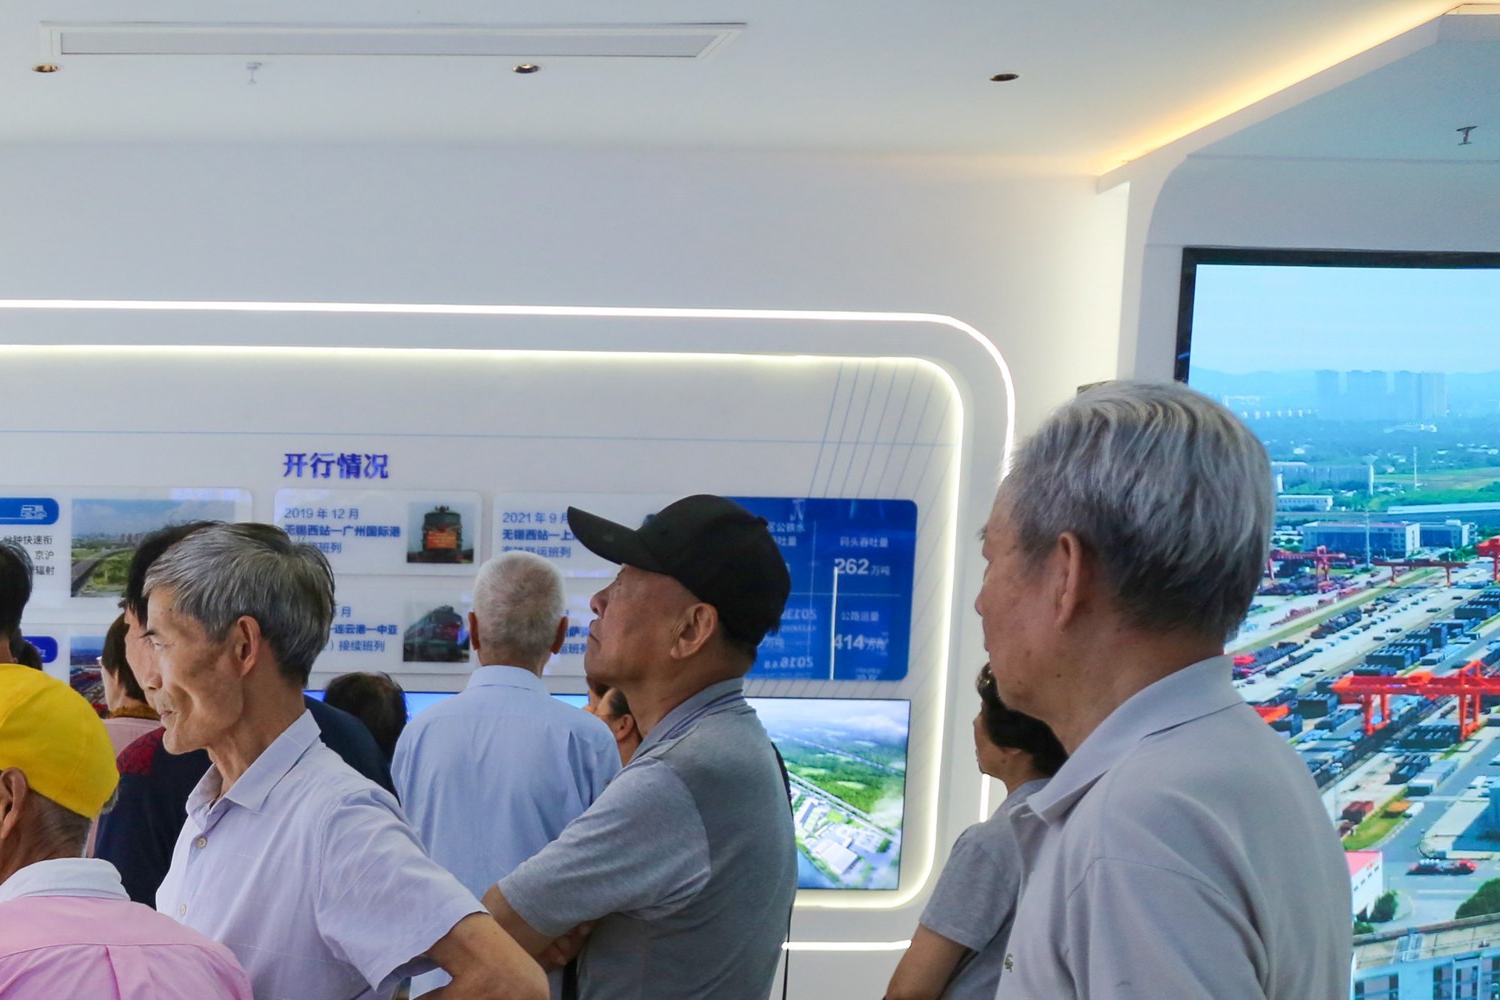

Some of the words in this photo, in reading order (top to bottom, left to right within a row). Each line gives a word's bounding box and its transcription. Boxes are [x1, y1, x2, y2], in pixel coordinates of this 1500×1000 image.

[283, 452, 389, 479] 开行情况
[839, 536, 889, 548] 码头吞吐量
[834, 558, 869, 575] 262
